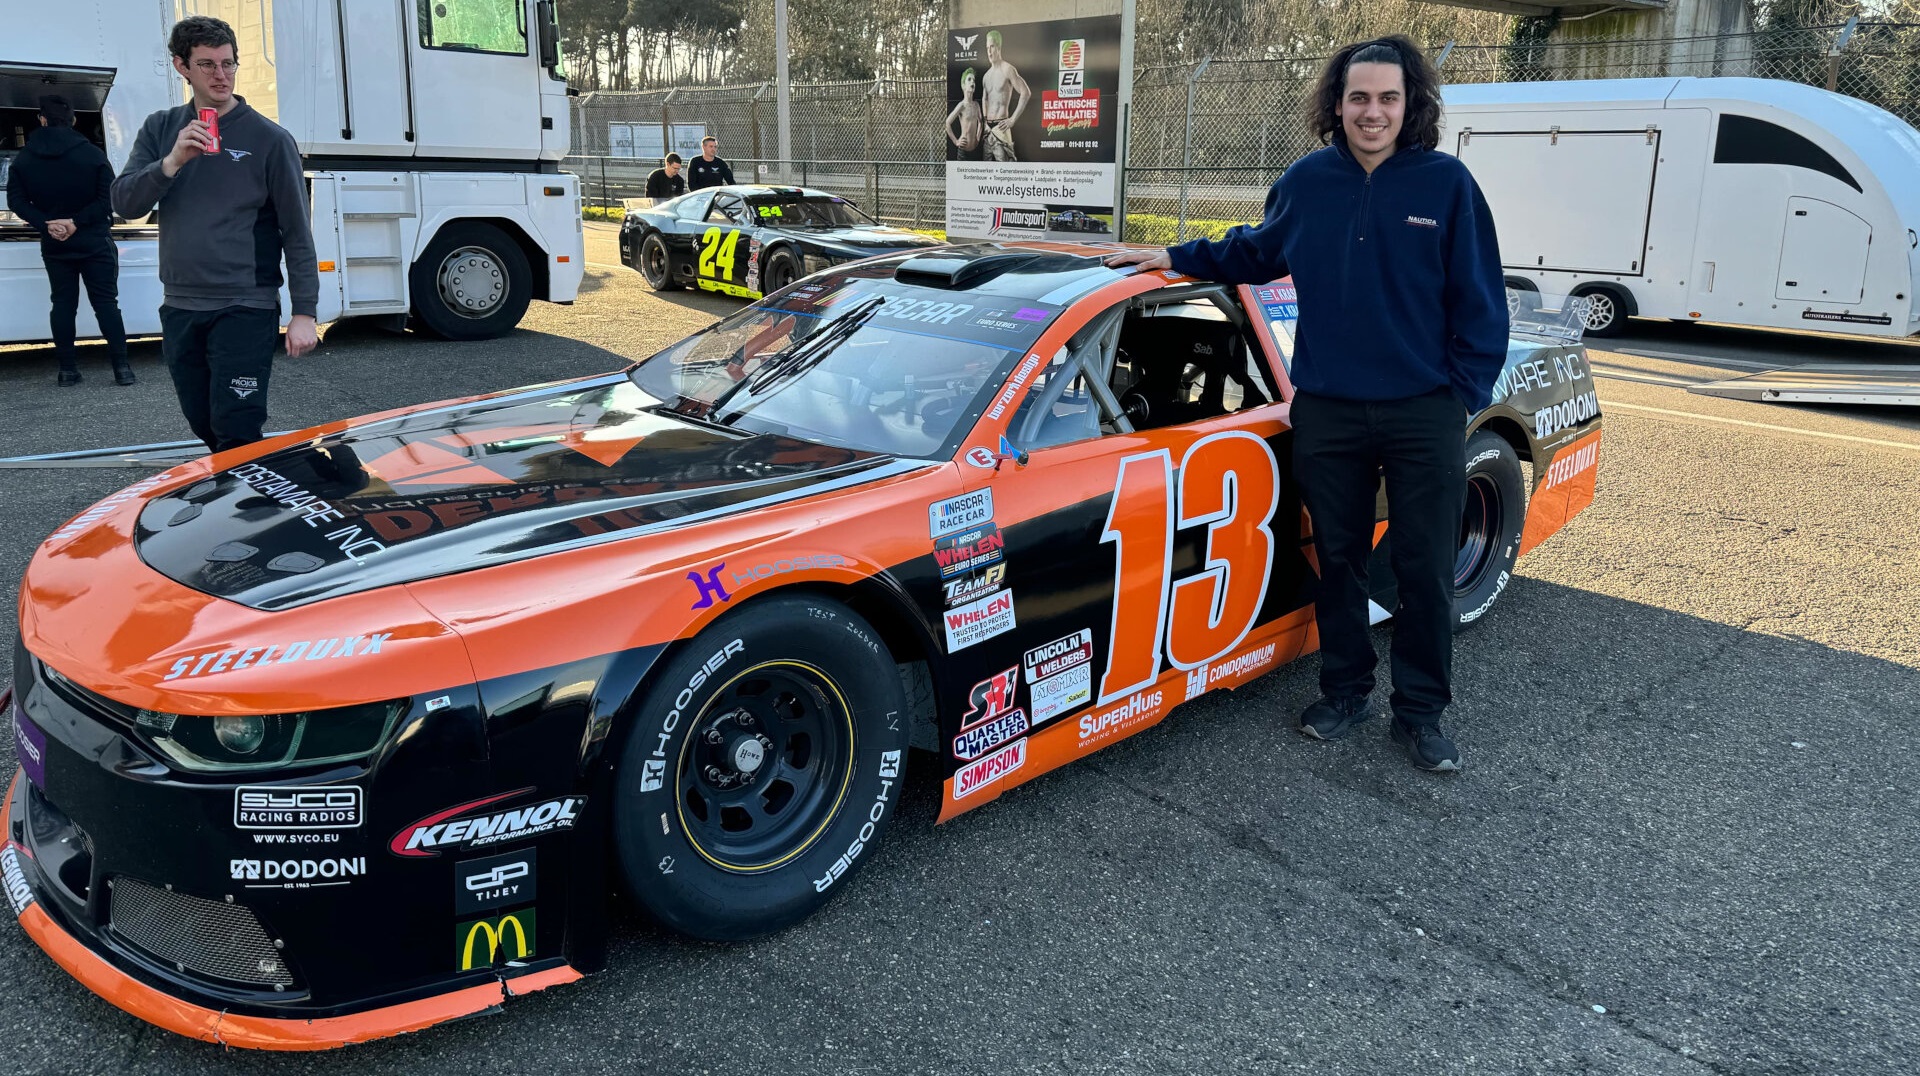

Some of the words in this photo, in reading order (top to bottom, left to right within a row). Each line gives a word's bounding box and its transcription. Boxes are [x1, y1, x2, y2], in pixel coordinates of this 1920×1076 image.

[1060, 87, 1082, 97] Systems
[1061, 72, 1082, 86] EL
[1043, 99, 1098, 110] ELEKTRISCHE
[1043, 109, 1097, 120] INSTALLATIES
[978, 184, 1076, 199] www.elsystems.be
[758, 205, 783, 217] 24
[1002, 211, 1045, 227] motorsport
[1407, 215, 1437, 225] NAUTICA
[699, 226, 741, 281] 24
[976, 318, 994, 326] EURO
[994, 320, 1018, 329] SERIES
[1553, 390, 1598, 433] DODONI
[1545, 440, 1599, 491] STEELDUXX
[227, 463, 345, 528] COSTAMARE
[323, 524, 387, 567] INC.
[948, 494, 984, 512] NASCAR
[939, 515, 964, 530] RACE
[965, 508, 986, 522] CAR
[932, 530, 1005, 568] WHELEN
[958, 530, 982, 544] NASCAR
[731, 554, 848, 586] HOOSIER
[954, 561, 971, 572] EURO
[970, 552, 990, 567] SERIES
[1095, 430, 1280, 708] 13
[951, 584, 1000, 606] ORGANIZATION
[1459, 587, 1502, 624] HOOSIER
[946, 593, 1010, 631] WHELEN
[952, 624, 979, 639] TRUSTED
[979, 622, 988, 630] TO
[987, 610, 1012, 627] PROTECT
[957, 634, 974, 646] FIRST
[974, 620, 1010, 641] RESPONDERS
[163, 632, 392, 680] STEELDUXX
[1027, 634, 1080, 667] LINCOLN
[1040, 648, 1086, 676] WELDERS
[1209, 642, 1276, 684] CONDOMINIUM
[1241, 656, 1272, 675] PARTNERS
[652, 638, 745, 757] HOOSIER
[955, 709, 1023, 756] QUARTER
[968, 721, 1027, 759] MASTER
[1077, 730, 1110, 749] WONING
[1120, 707, 1161, 731] VILLABOUW
[959, 743, 1022, 793] SIMPSON
[240, 792, 356, 808] SYCO
[240, 812, 294, 823] RACING
[299, 811, 356, 822] RADIOS
[404, 798, 577, 850] KENNOL
[252, 833, 340, 844] WWW.SYCO.EU
[470, 822, 556, 847] PERFORMANCE
[556, 819, 573, 828] OIL
[812, 779, 894, 893] HOOSIER
[1, 844, 35, 911] KENNOL
[264, 857, 367, 880] DODONI
[475, 885, 519, 901] TIJEY
